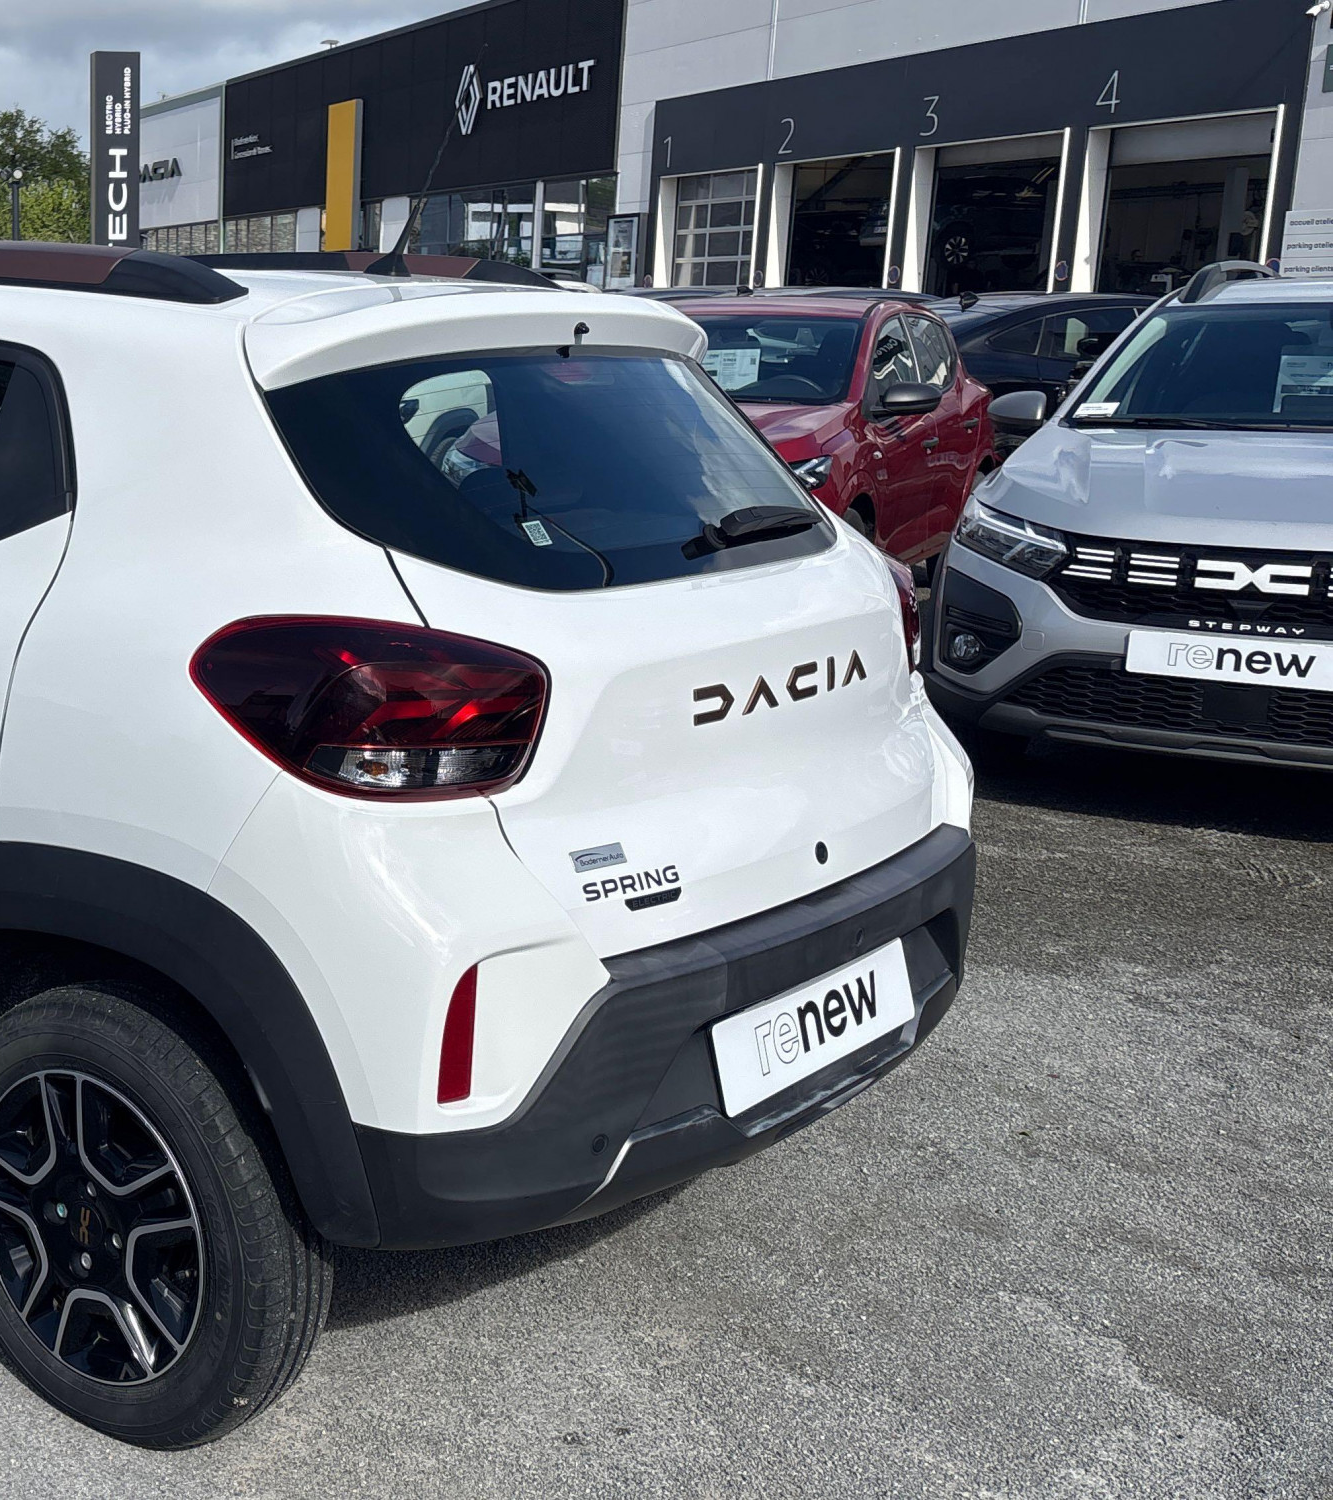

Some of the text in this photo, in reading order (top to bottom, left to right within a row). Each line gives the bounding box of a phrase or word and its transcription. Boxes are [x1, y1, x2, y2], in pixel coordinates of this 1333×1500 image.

[123, 66, 132, 134] PLUG-IN HYBRID
[486, 59, 597, 110] RENAULT
[1095, 70, 1120, 114] 4
[105, 95, 114, 134] ELECTRIC
[114, 102, 122, 134] HYBRID
[919, 95, 940, 137] 3
[663, 136, 675, 168] 1
[777, 118, 797, 155] 2
[139, 157, 183, 184] ACIA
[108, 148, 128, 247] ECH
[1286, 242, 1313, 251] parking
[1187, 619, 1306, 635] STEPWAY
[1167, 642, 1317, 678] renew
[693, 649, 867, 727] DACIA
[582, 864, 680, 902] SPRING
[632, 890, 677, 908] ELECTRIC
[754, 969, 877, 1077] renew
